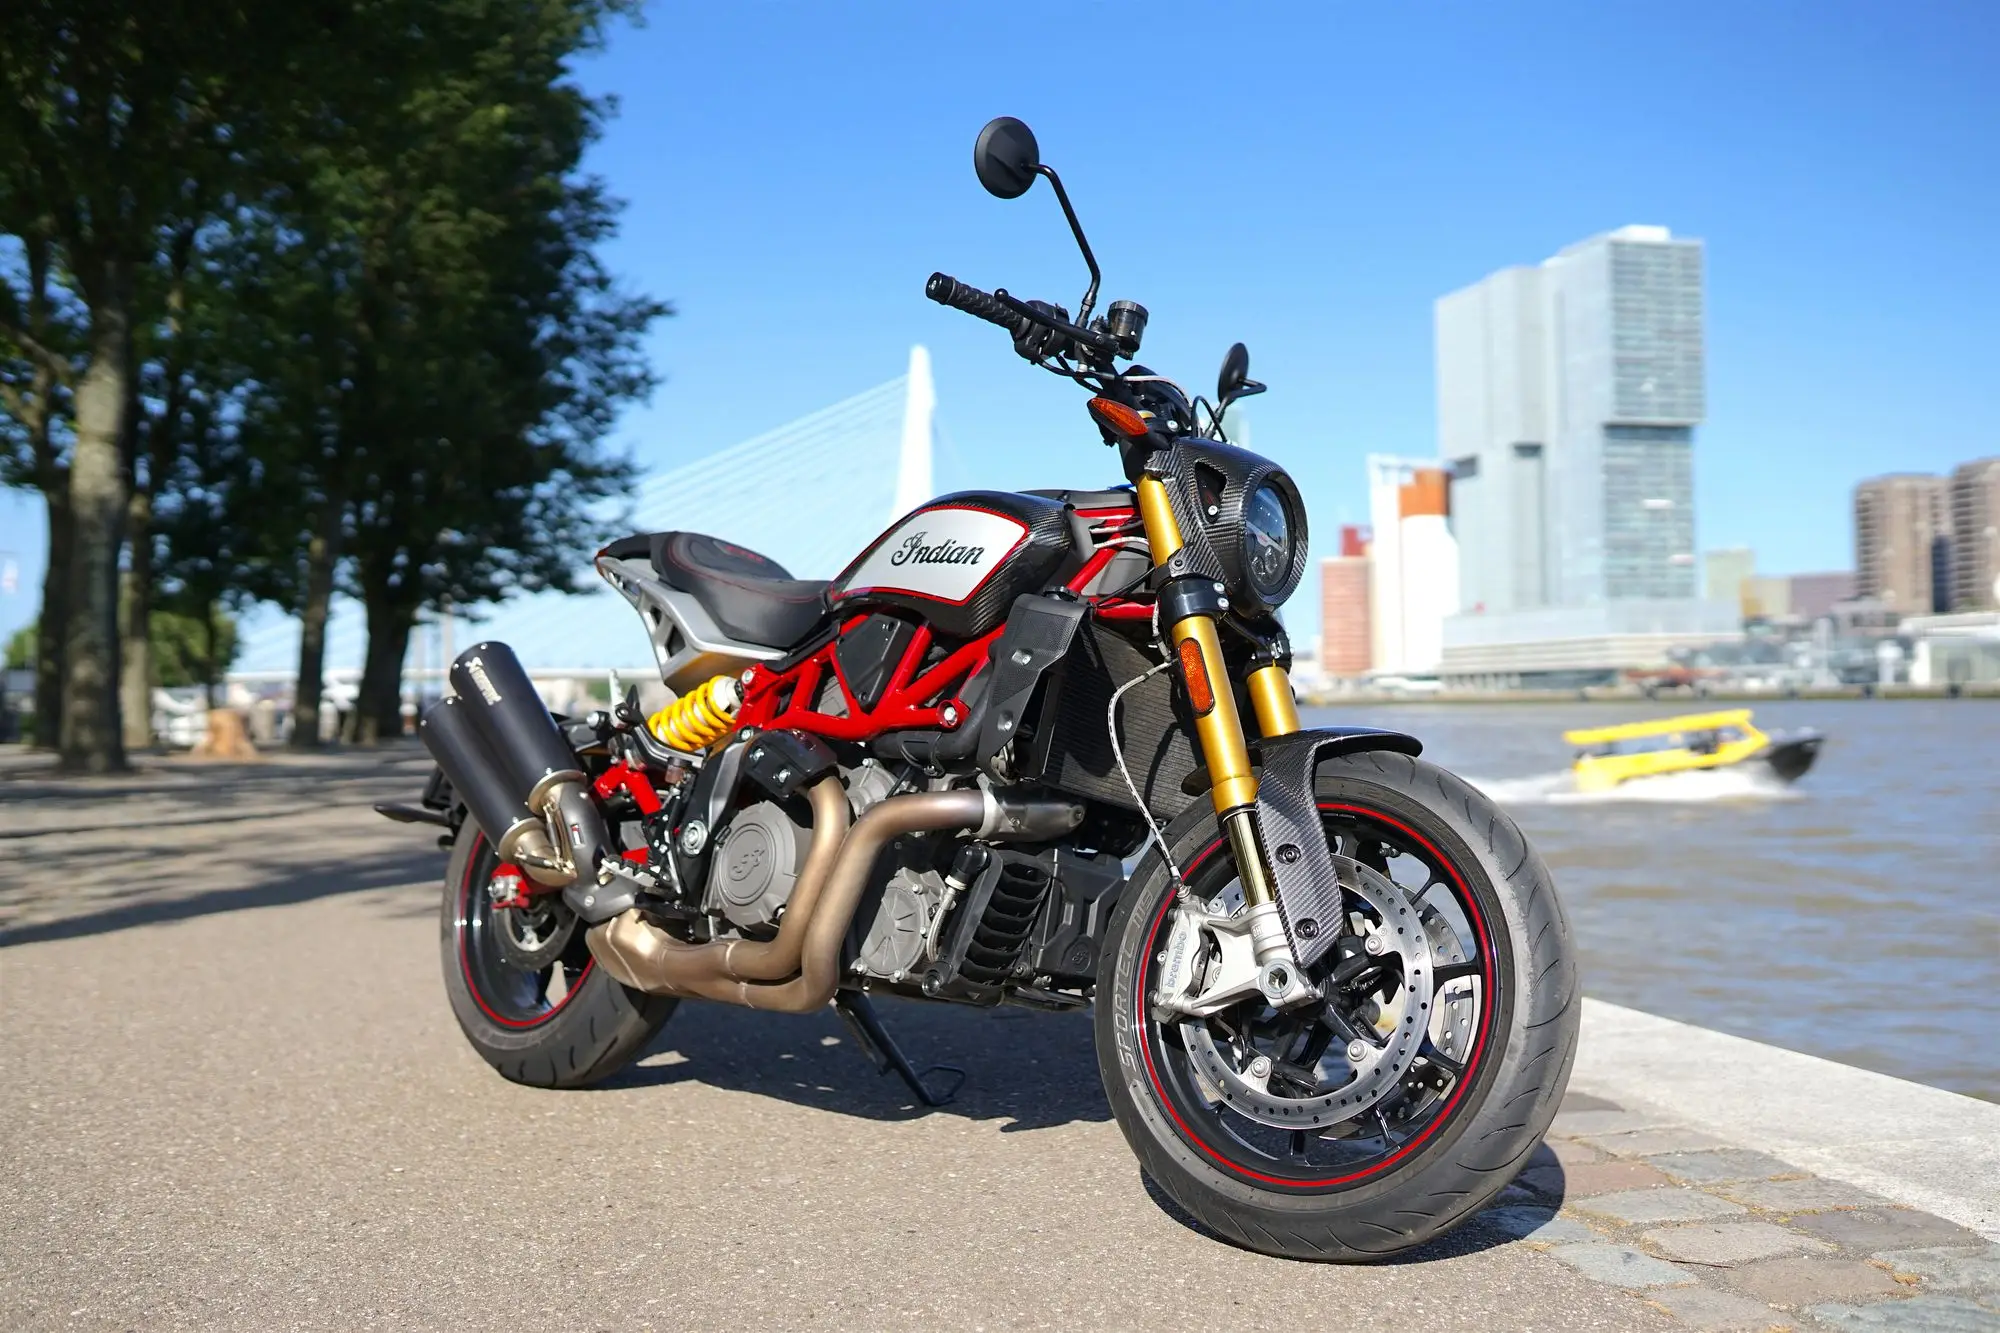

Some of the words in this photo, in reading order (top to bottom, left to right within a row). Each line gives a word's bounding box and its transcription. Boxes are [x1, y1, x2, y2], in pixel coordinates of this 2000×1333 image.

[891, 531, 985, 566] Indian
[1165, 931, 1187, 987] brembo
[1114, 936, 1137, 1073] SPORTEC
